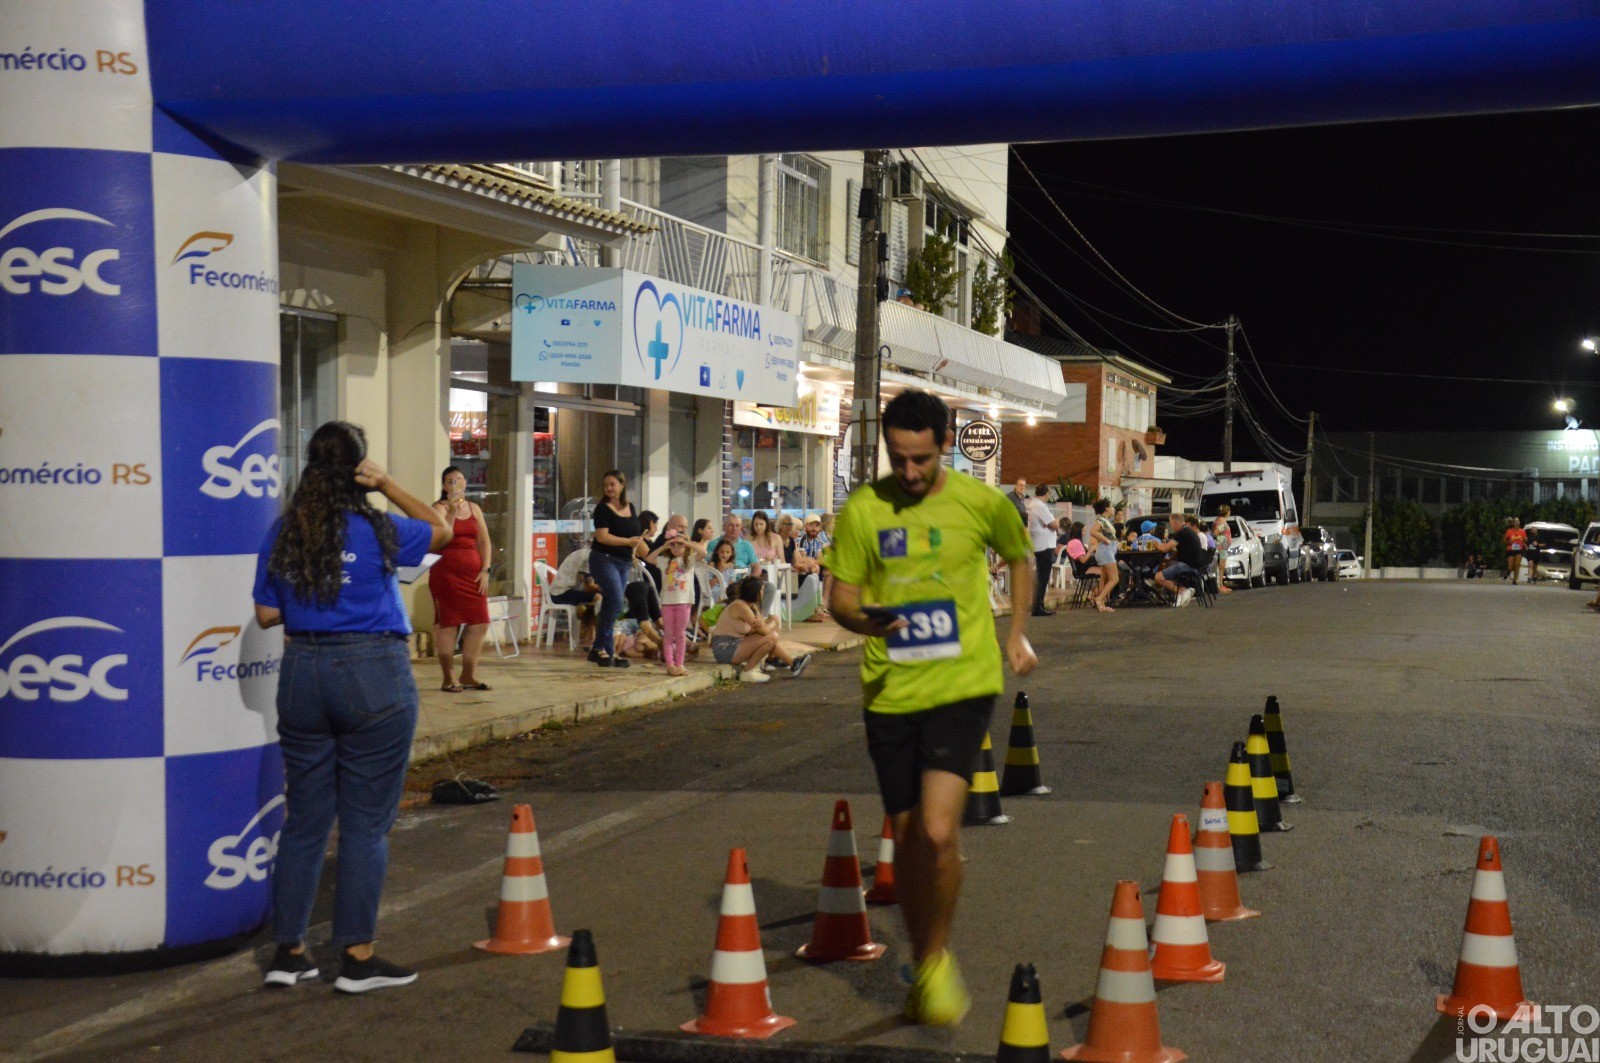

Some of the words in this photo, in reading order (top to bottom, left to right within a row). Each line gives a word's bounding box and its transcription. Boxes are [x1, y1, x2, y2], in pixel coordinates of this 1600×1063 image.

[96, 49, 138, 76] RS
[546, 298, 616, 311] VITAFARMA
[682, 291, 761, 341] VITAFARMA
[112, 463, 151, 486] RS
[0, 653, 128, 702] esc
[116, 864, 156, 888] RS
